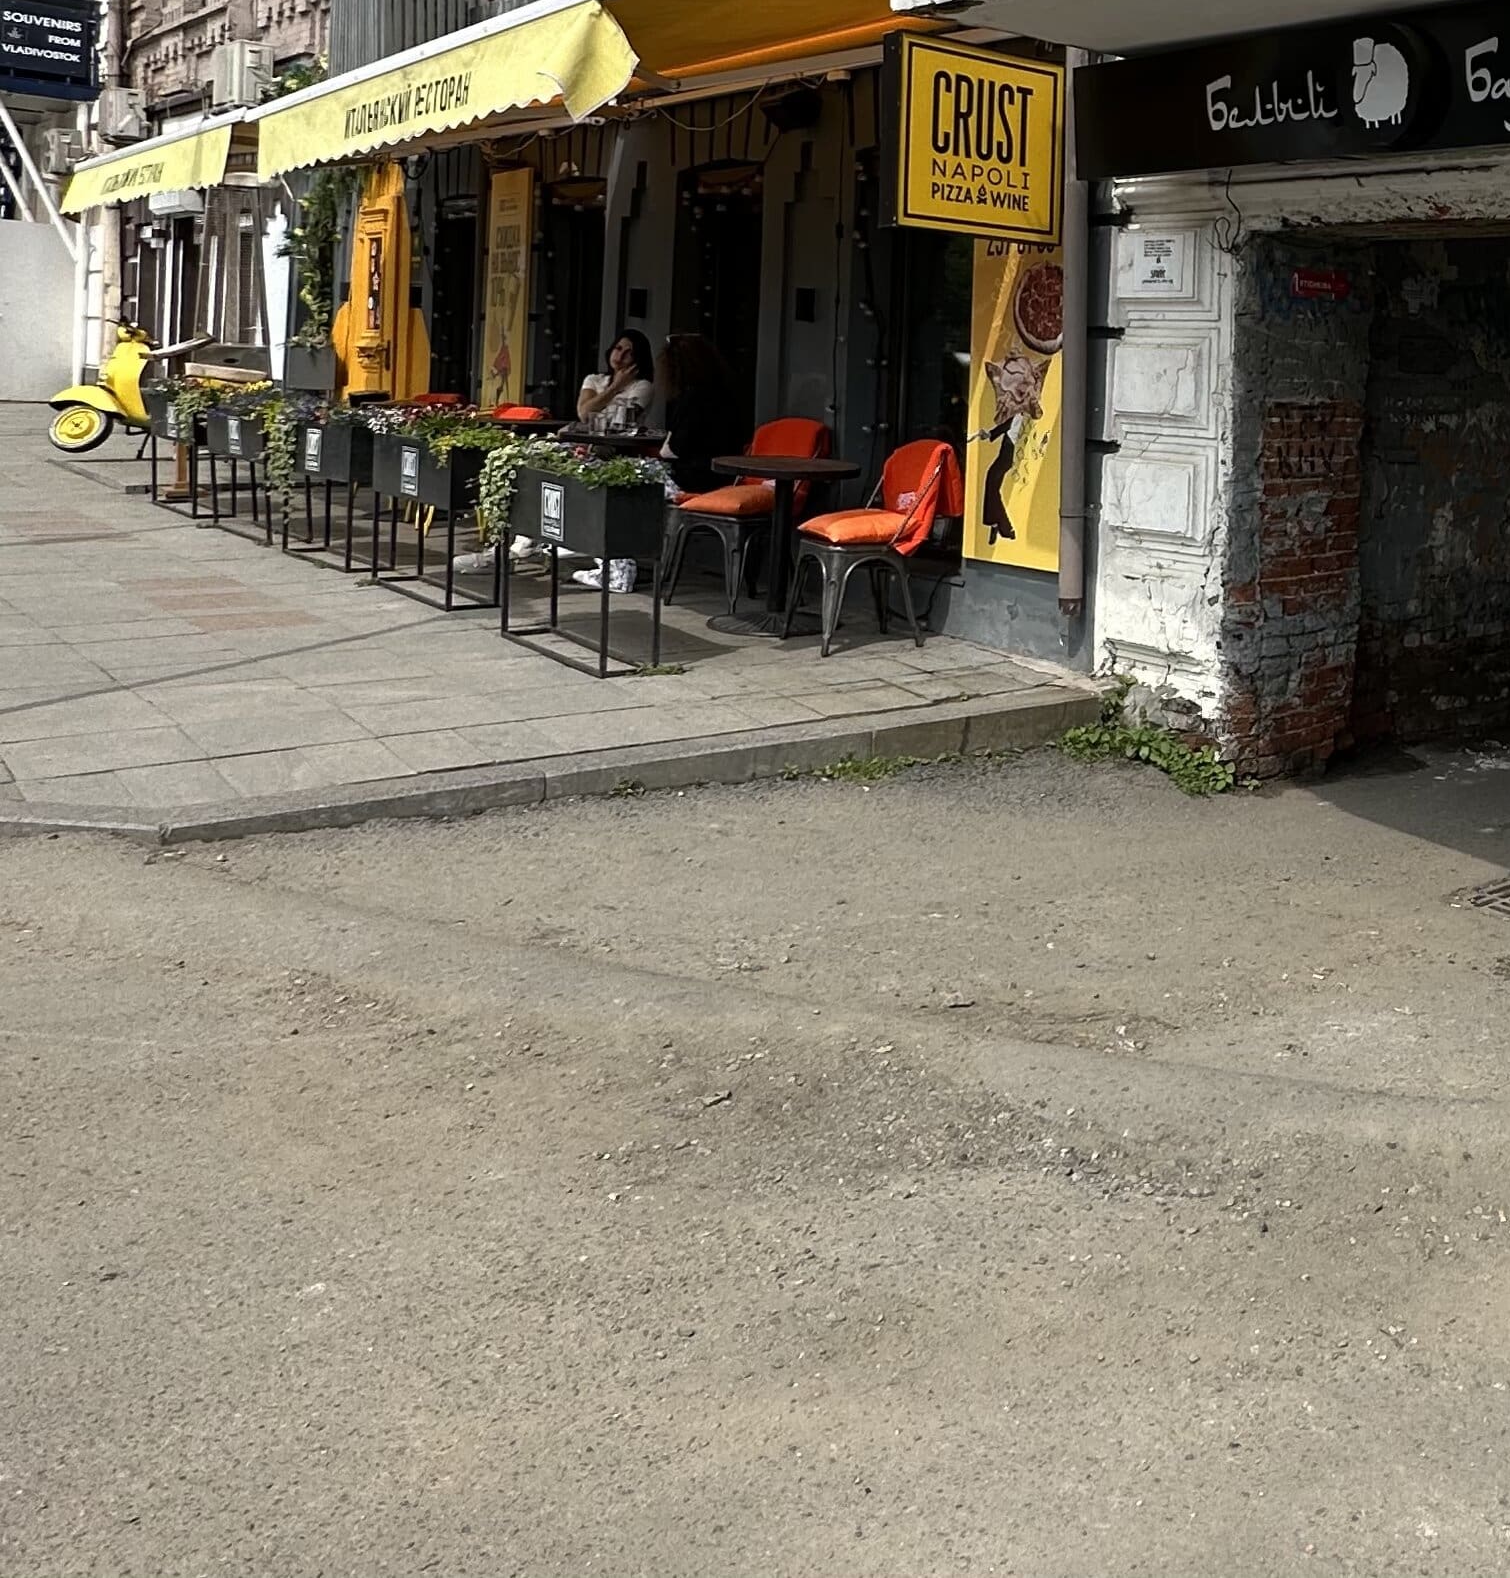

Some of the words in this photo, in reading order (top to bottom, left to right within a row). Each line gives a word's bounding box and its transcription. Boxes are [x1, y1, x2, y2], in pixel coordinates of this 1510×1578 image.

[3, 10, 82, 32] SOUVENIRS
[2, 43, 81, 63] VLADIVOSTOK
[48, 35, 81, 47] FROM
[414, 71, 472, 119] РЕСТОРАН
[931, 70, 1034, 167] CRUST
[932, 157, 1030, 191] NAPOLI
[931, 182, 974, 205] PIZZA
[990, 192, 1030, 212] WINE
